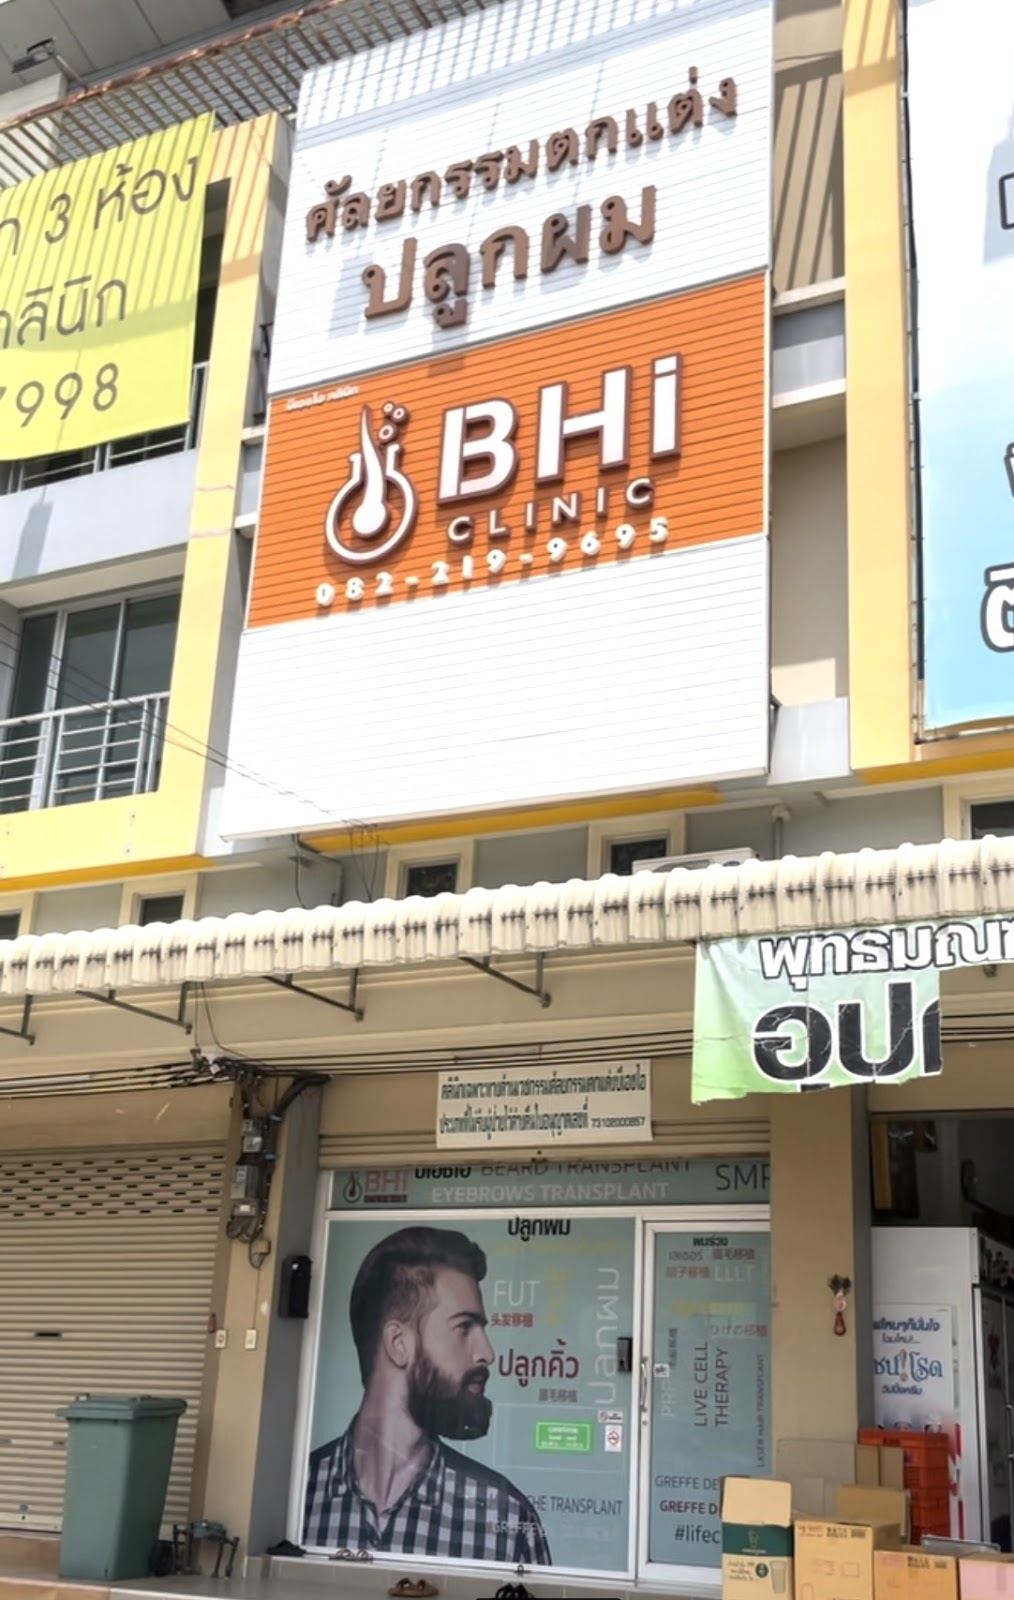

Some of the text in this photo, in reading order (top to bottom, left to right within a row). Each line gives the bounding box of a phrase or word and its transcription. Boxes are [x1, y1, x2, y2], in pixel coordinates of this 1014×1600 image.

[305, 65, 738, 243] ศัลยกรรมตกแต่ง
[44, 192, 72, 244] 3
[93, 156, 199, 230] ห้อง
[361, 184, 658, 330] ปลูกผม
[0, 362, 119, 428] 998
[446, 476, 655, 544] CLINIC
[314, 515, 670, 607] 082-219-9695
[432, 1181, 670, 1203] EYEBROWS TRANSPLANT
[493, 1279, 541, 1307] FUT
[498, 1338, 580, 1388] ปลูกคิ้ว
[694, 1341, 709, 1427] LIVE CELL
[715, 1348, 729, 1428] THERAPY
[550, 1497, 624, 1517] TRANSPLANT
[655, 1475, 700, 1490] GREFFE
[660, 1499, 718, 1515] GREFFE D
